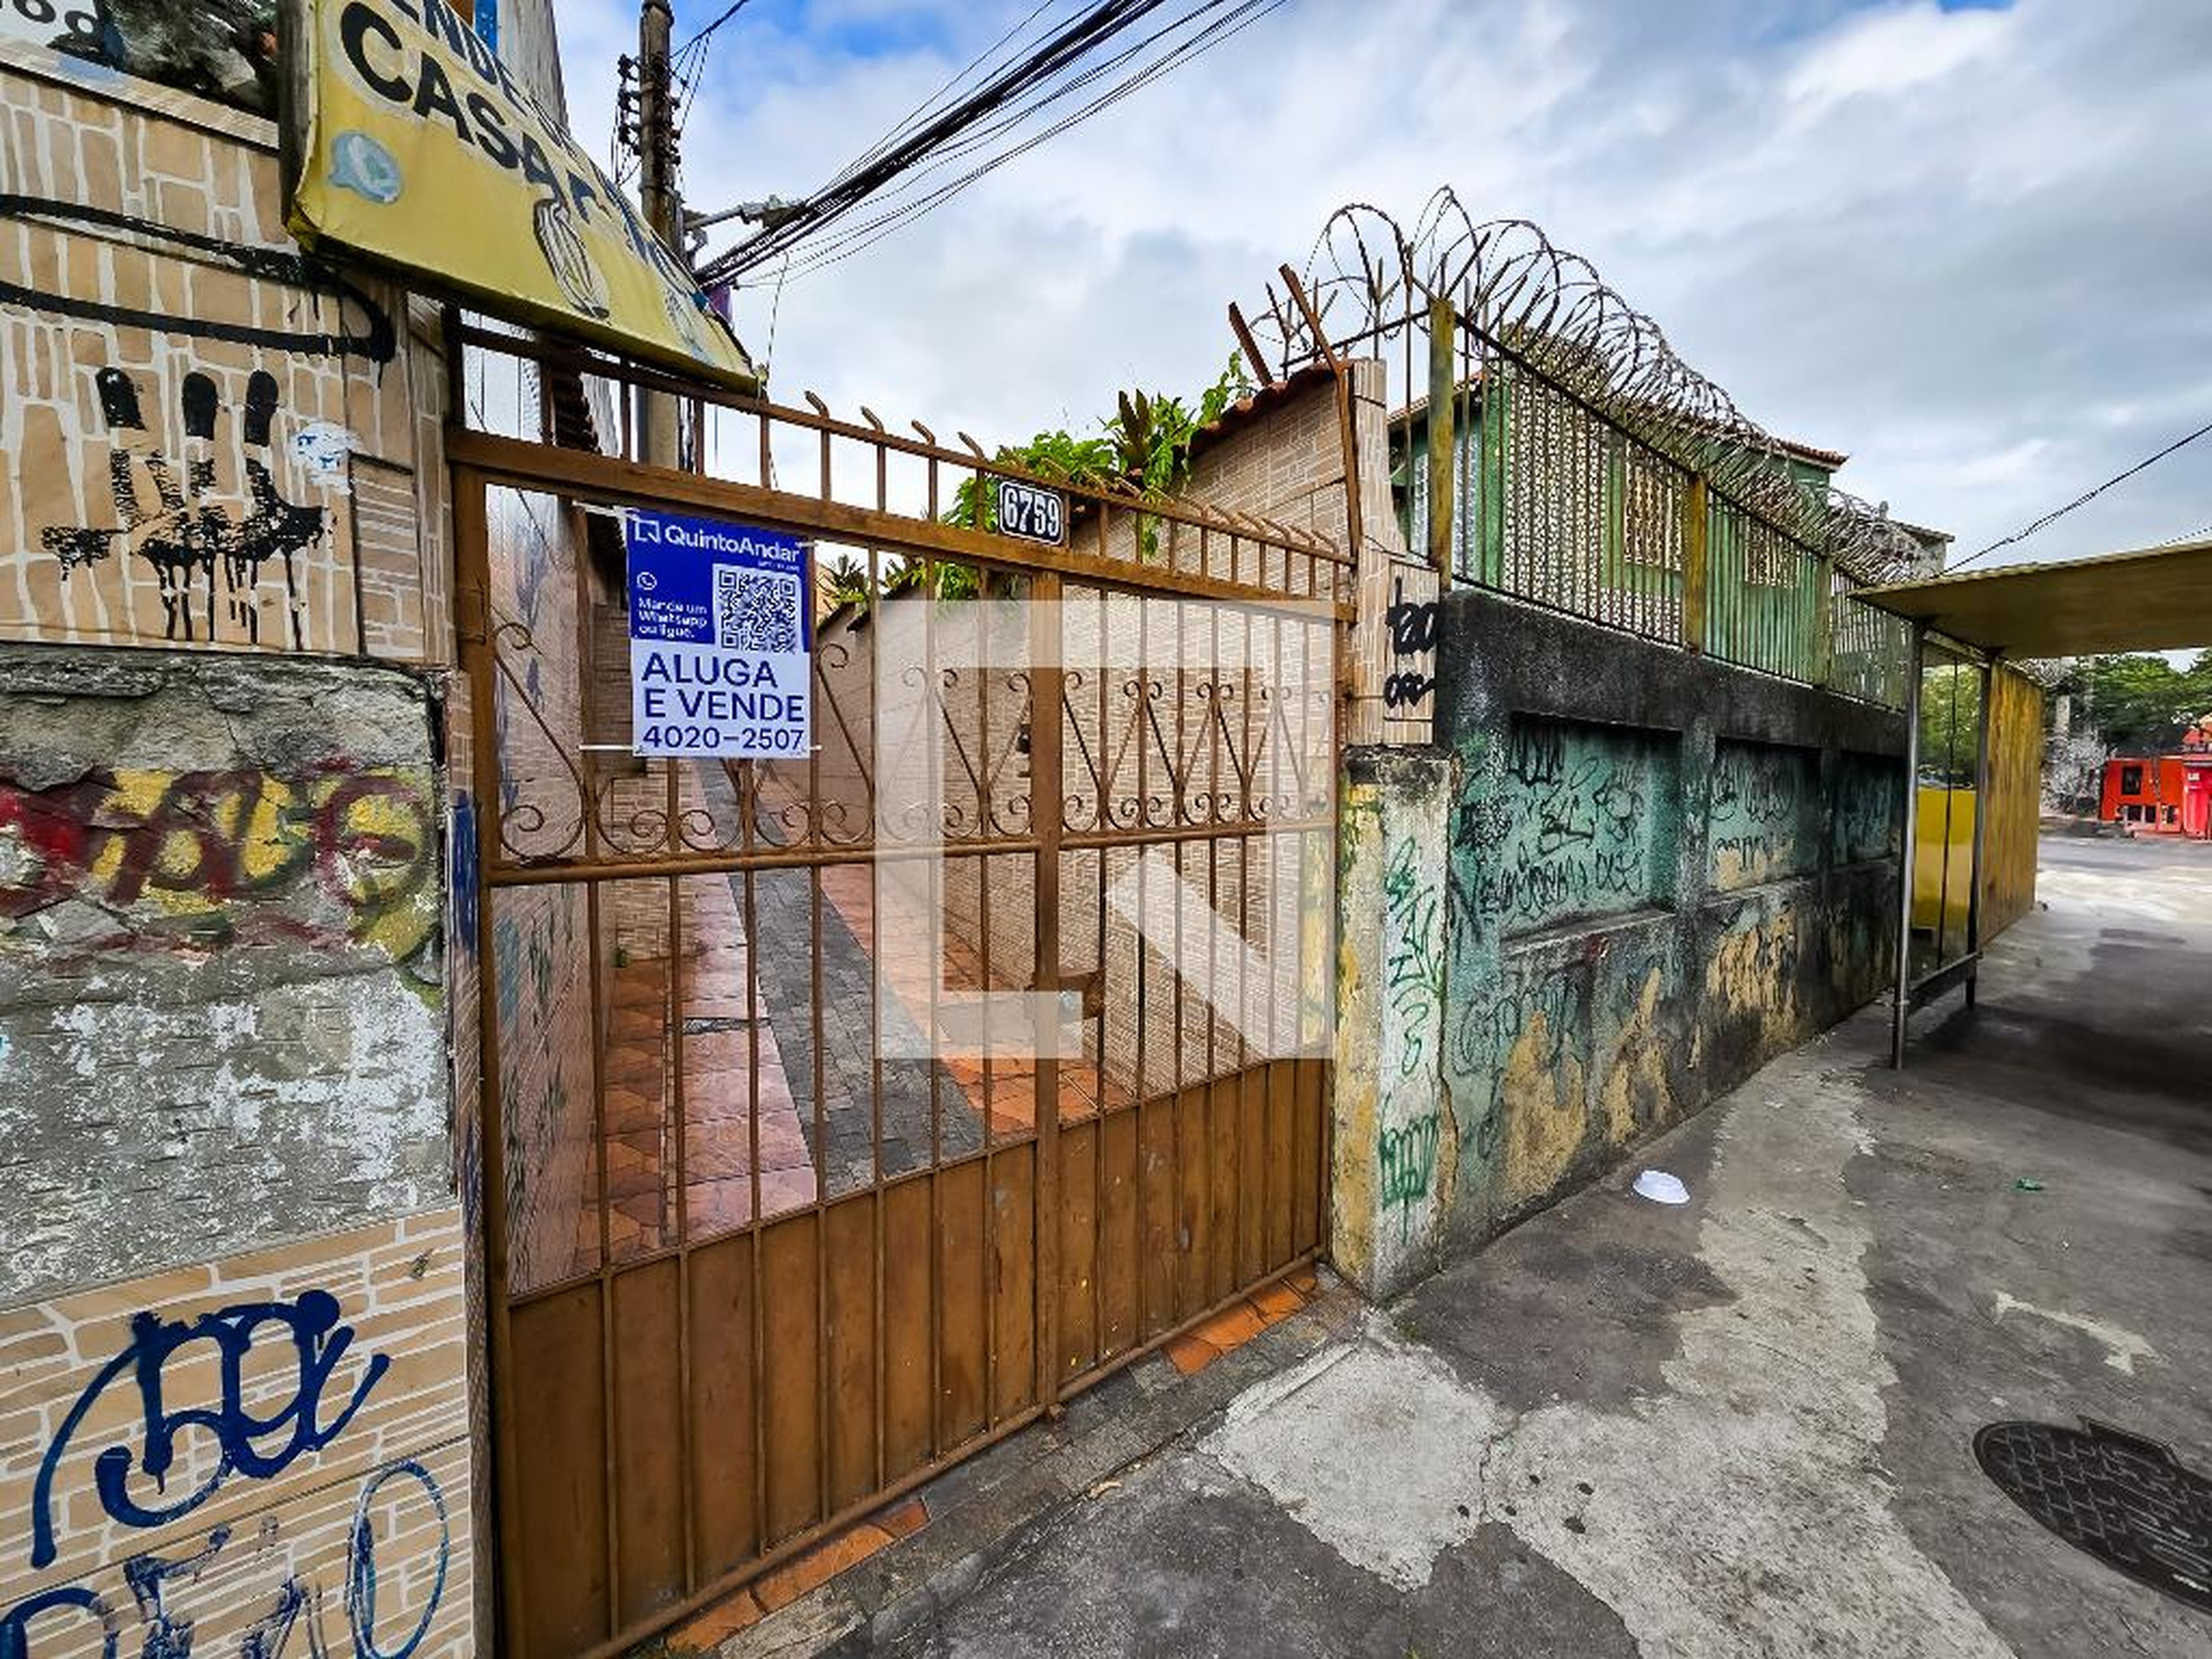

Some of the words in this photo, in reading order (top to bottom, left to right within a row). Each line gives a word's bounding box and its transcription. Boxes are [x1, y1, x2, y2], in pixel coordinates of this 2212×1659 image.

[340, 2, 564, 204] CASA
[1004, 488, 1059, 536] 6759
[665, 525, 800, 562] QuintoAndar
[642, 652, 779, 688] ALUGA
[645, 688, 666, 718] E
[676, 690, 805, 722] VENDE
[642, 725, 805, 750] 4020-2507
